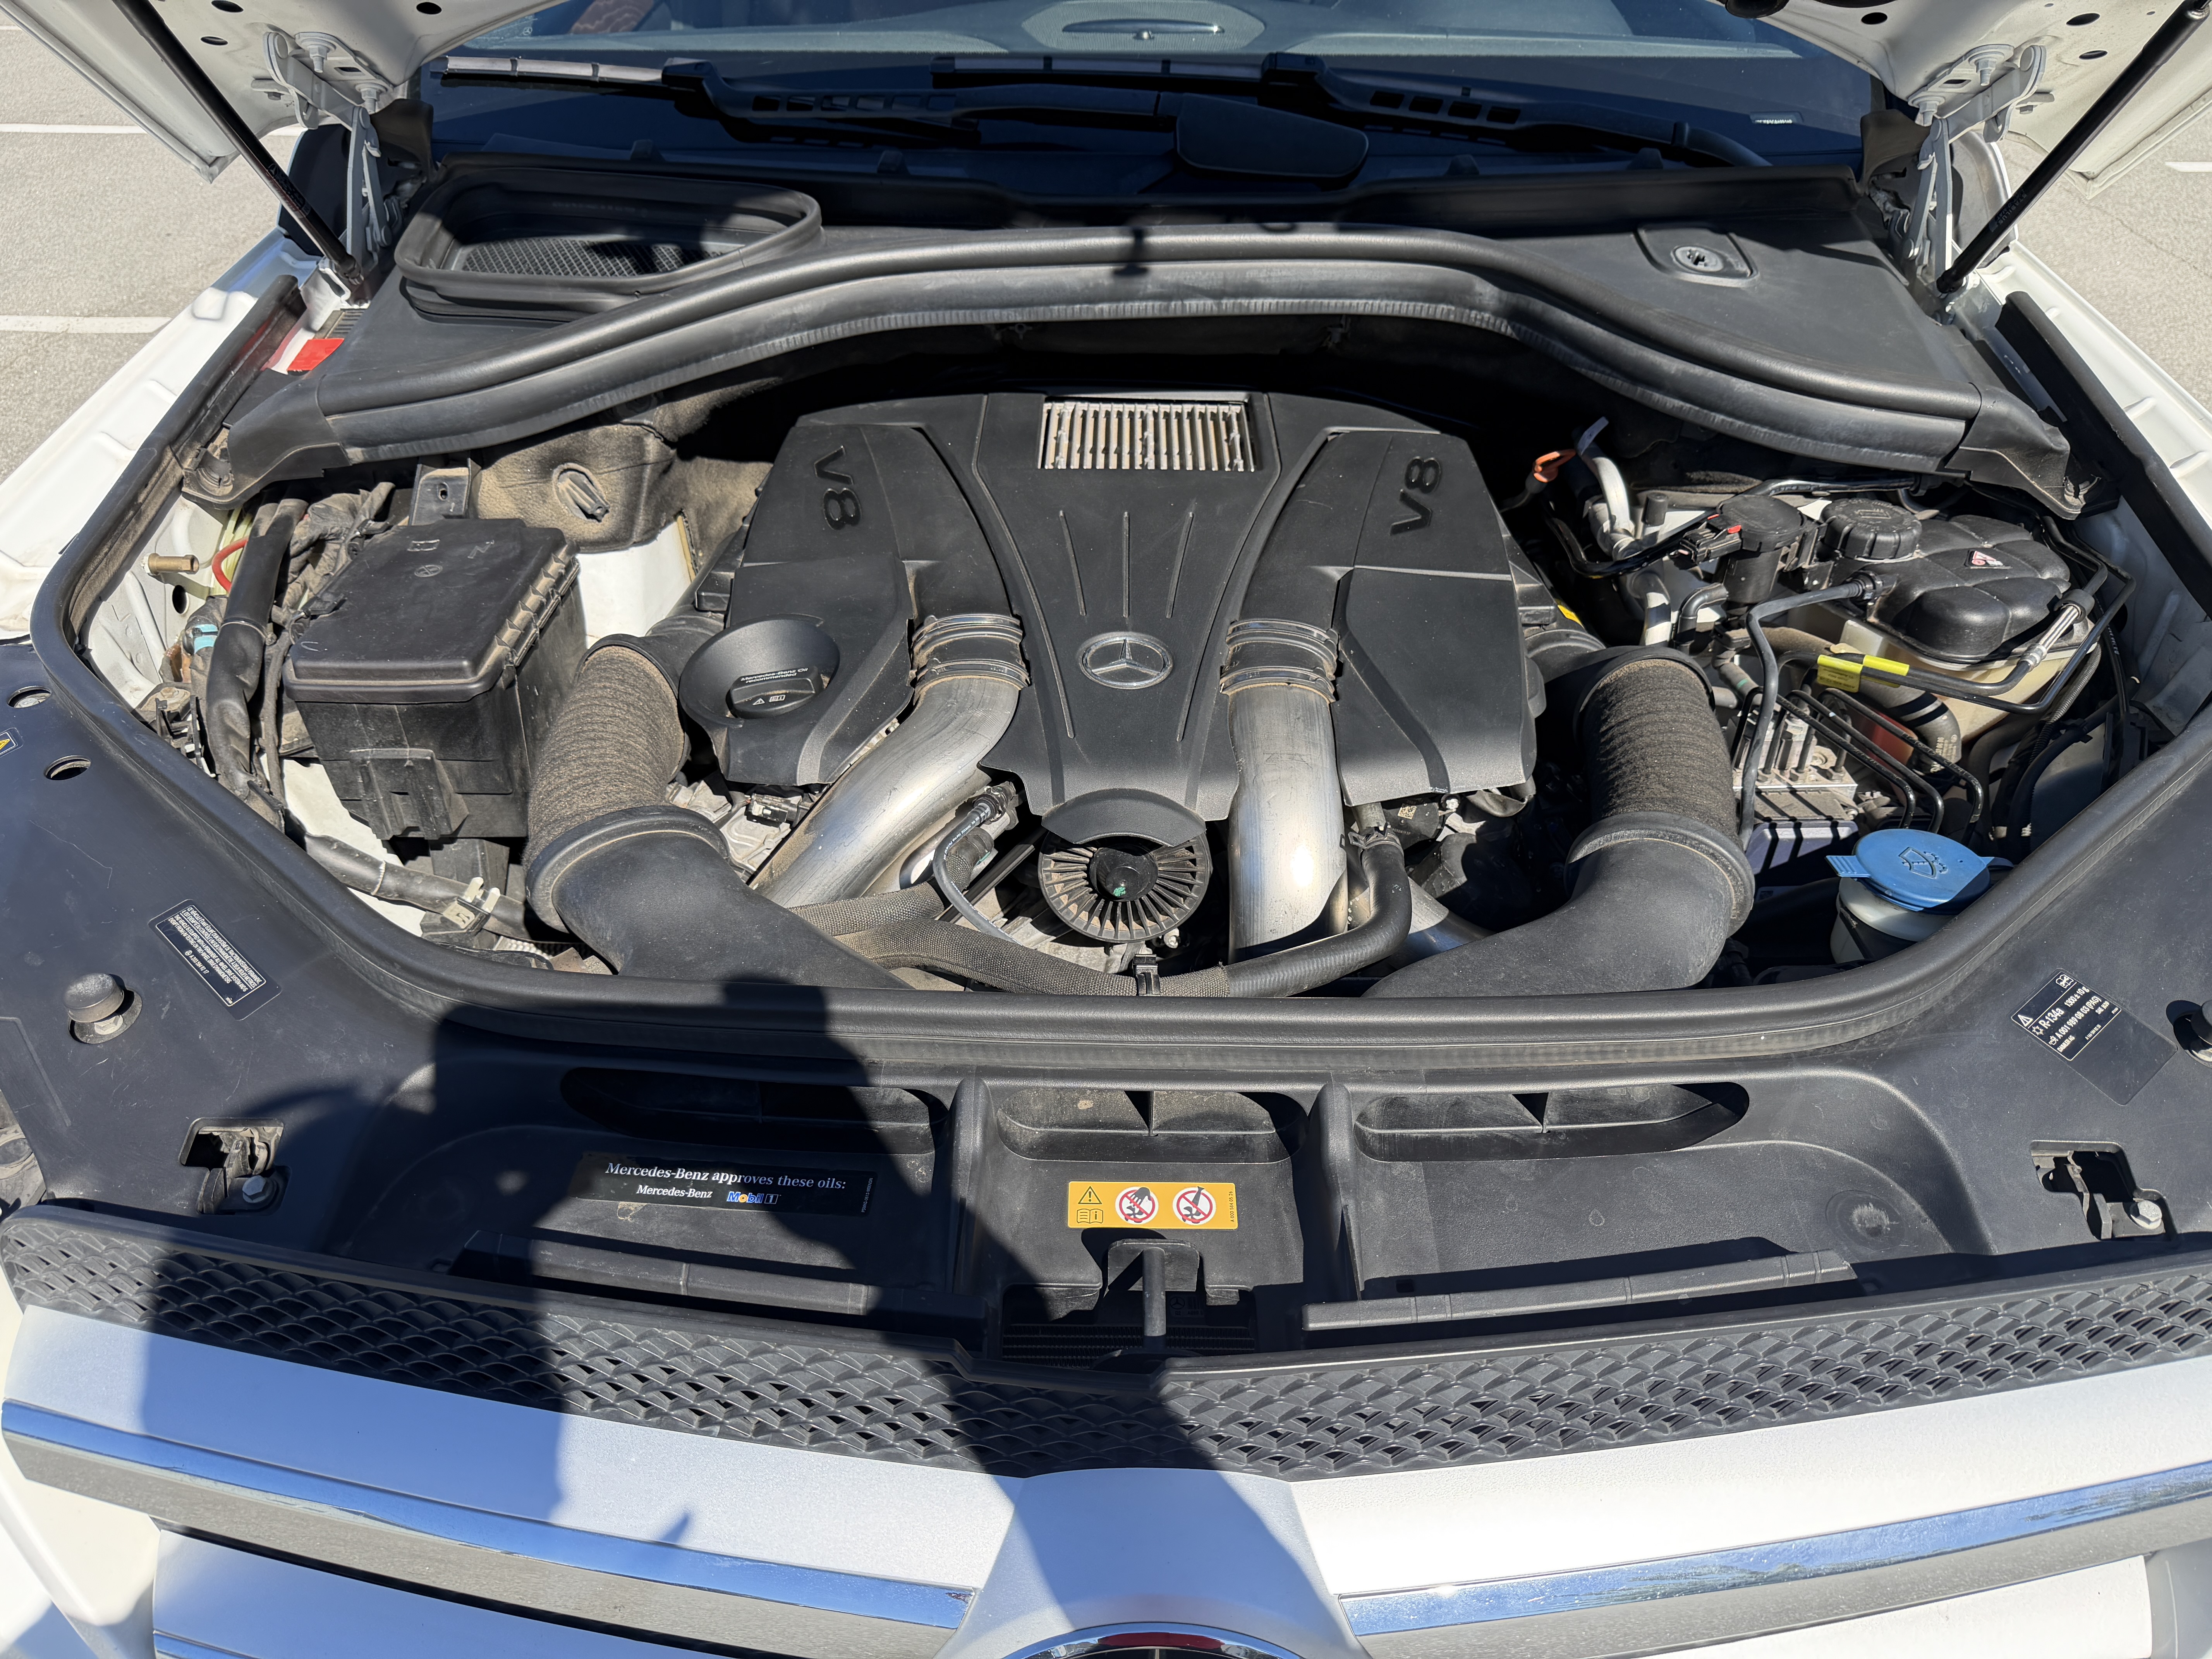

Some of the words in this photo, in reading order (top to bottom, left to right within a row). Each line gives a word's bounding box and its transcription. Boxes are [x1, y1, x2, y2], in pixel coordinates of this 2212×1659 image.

[814, 445, 862, 531] V8
[1389, 453, 1441, 536] V8
[741, 670, 796, 681] Mercedes-Benz
[746, 672, 797, 684] recommended
[2038, 1008, 2064, 1029] R-134a
[2064, 996, 2077, 1007] 1300
[2058, 1024, 2070, 1035] 001
[2066, 1017, 2078, 1027] 989
[2085, 996, 2101, 1009] (PAG)
[2057, 1039, 2071, 1052] DAIMLER
[606, 1163, 709, 1181] Mercedes-Benz
[712, 1172, 773, 1185] approves
[778, 1175, 814, 1188] these
[817, 1177, 847, 1189] oils:
[636, 1184, 713, 1198] Mercedes-Benz
[726, 1191, 764, 1204] Mobil
